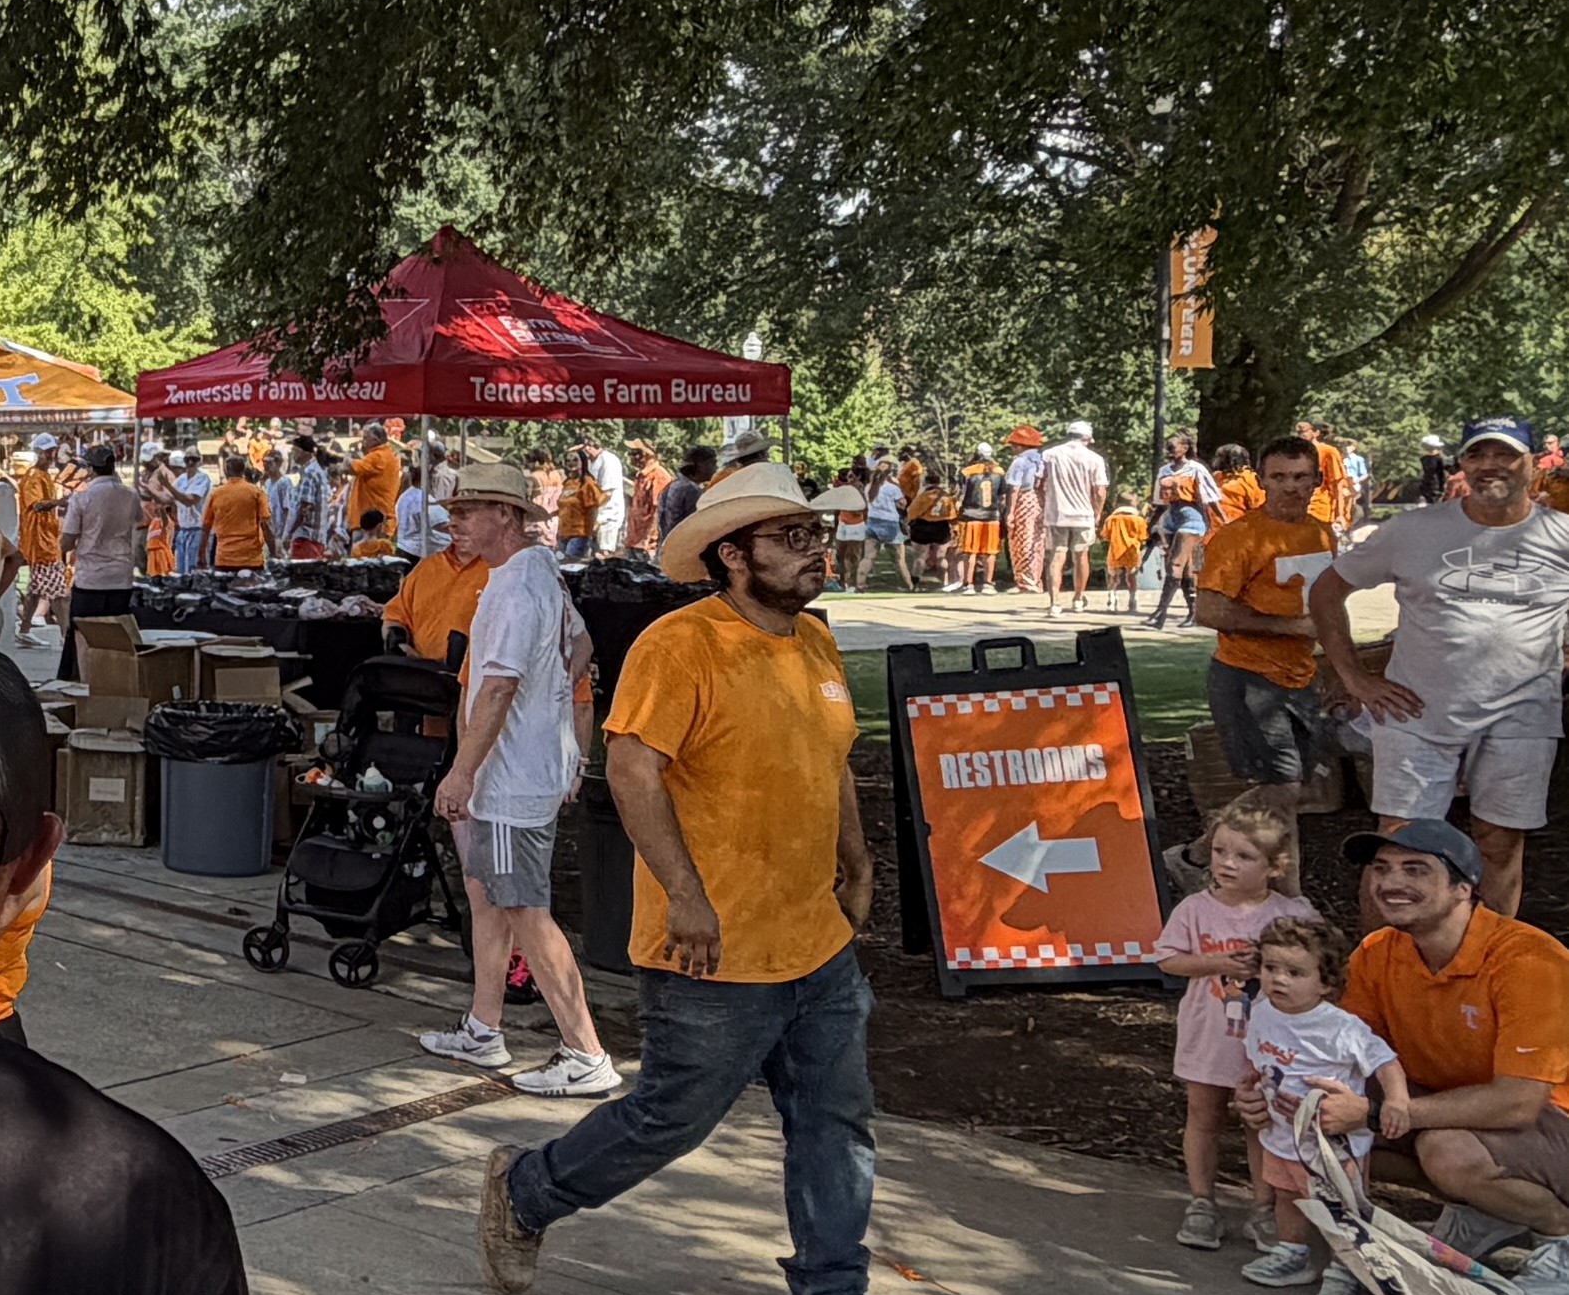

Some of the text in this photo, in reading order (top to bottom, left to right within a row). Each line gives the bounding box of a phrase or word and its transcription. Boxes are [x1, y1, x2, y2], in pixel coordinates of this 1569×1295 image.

[498, 315, 560, 331] Farm
[312, 378, 386, 401] Bureau
[470, 376, 752, 403] Tennessee Farm Bureau
[939, 744, 1108, 789] RESTROOMS
